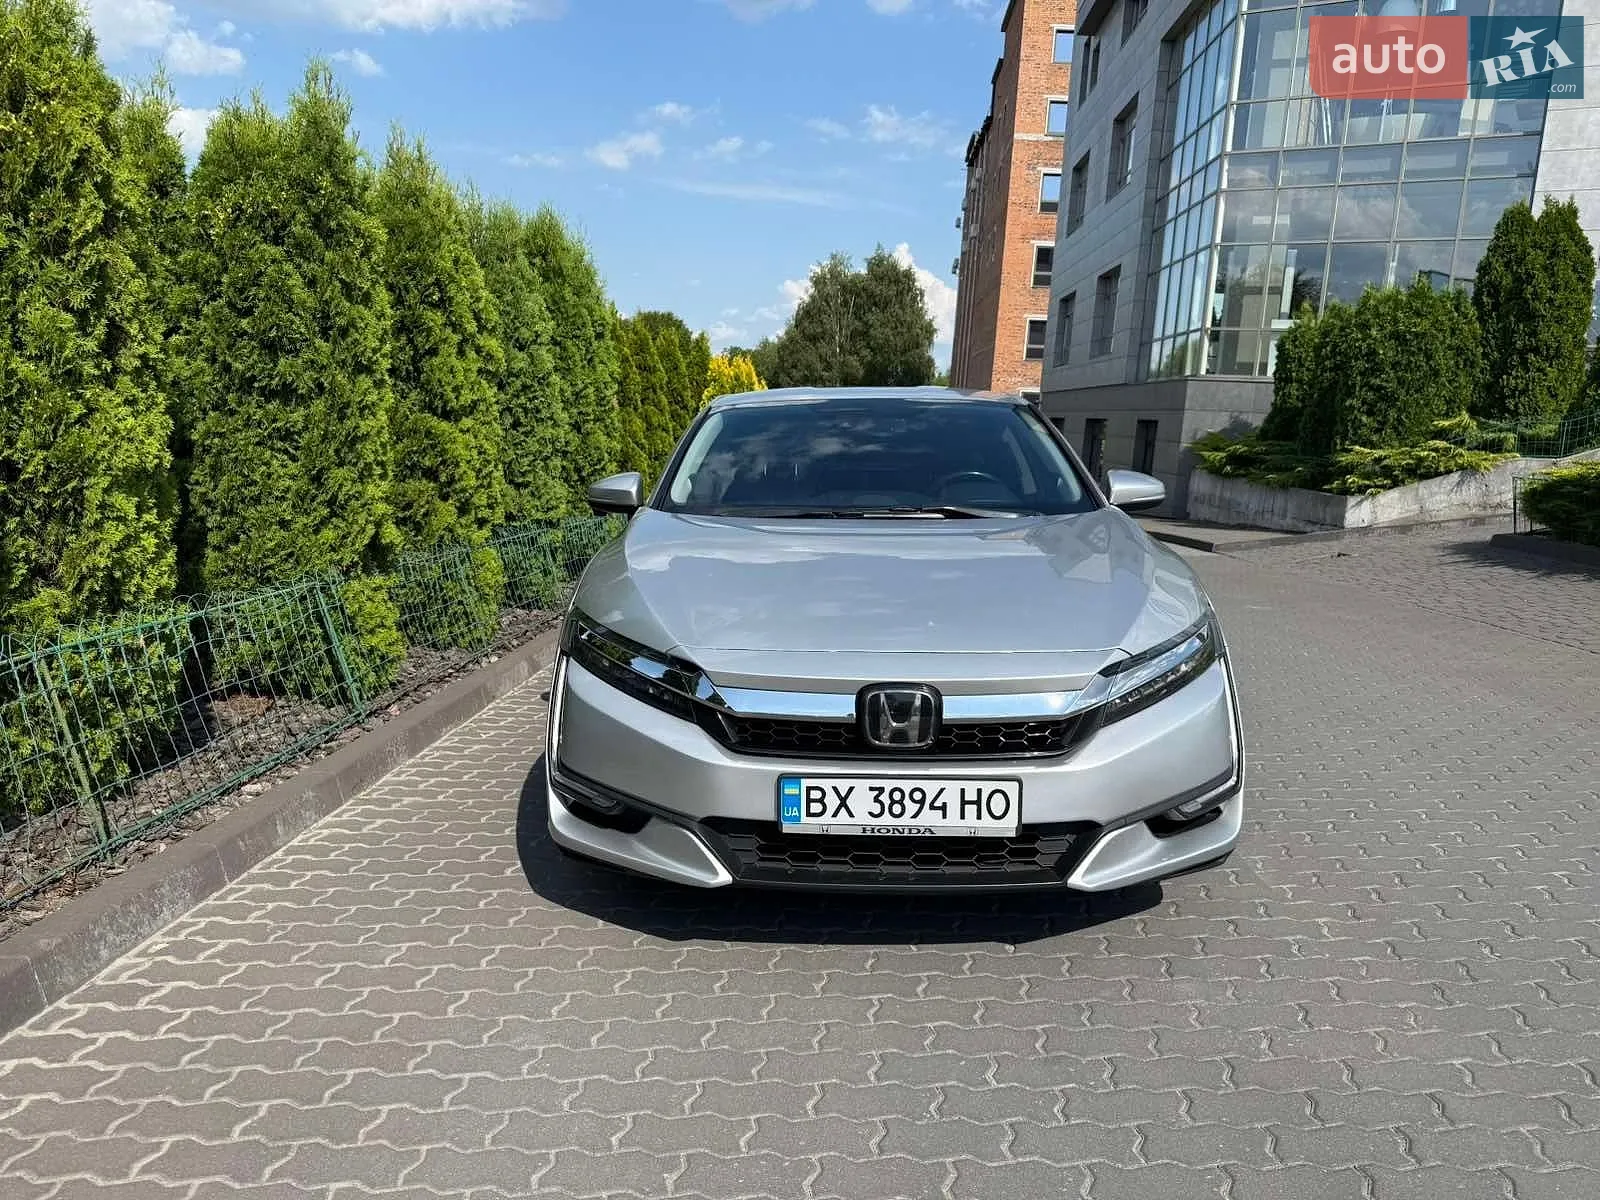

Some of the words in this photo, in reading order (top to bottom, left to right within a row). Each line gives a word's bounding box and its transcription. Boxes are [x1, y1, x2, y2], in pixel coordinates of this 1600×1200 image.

[805, 786, 855, 818] BX
[867, 786, 948, 819] 3894
[959, 787, 1011, 820] HO
[784, 807, 799, 817] UA
[860, 826, 936, 835] HONDA
